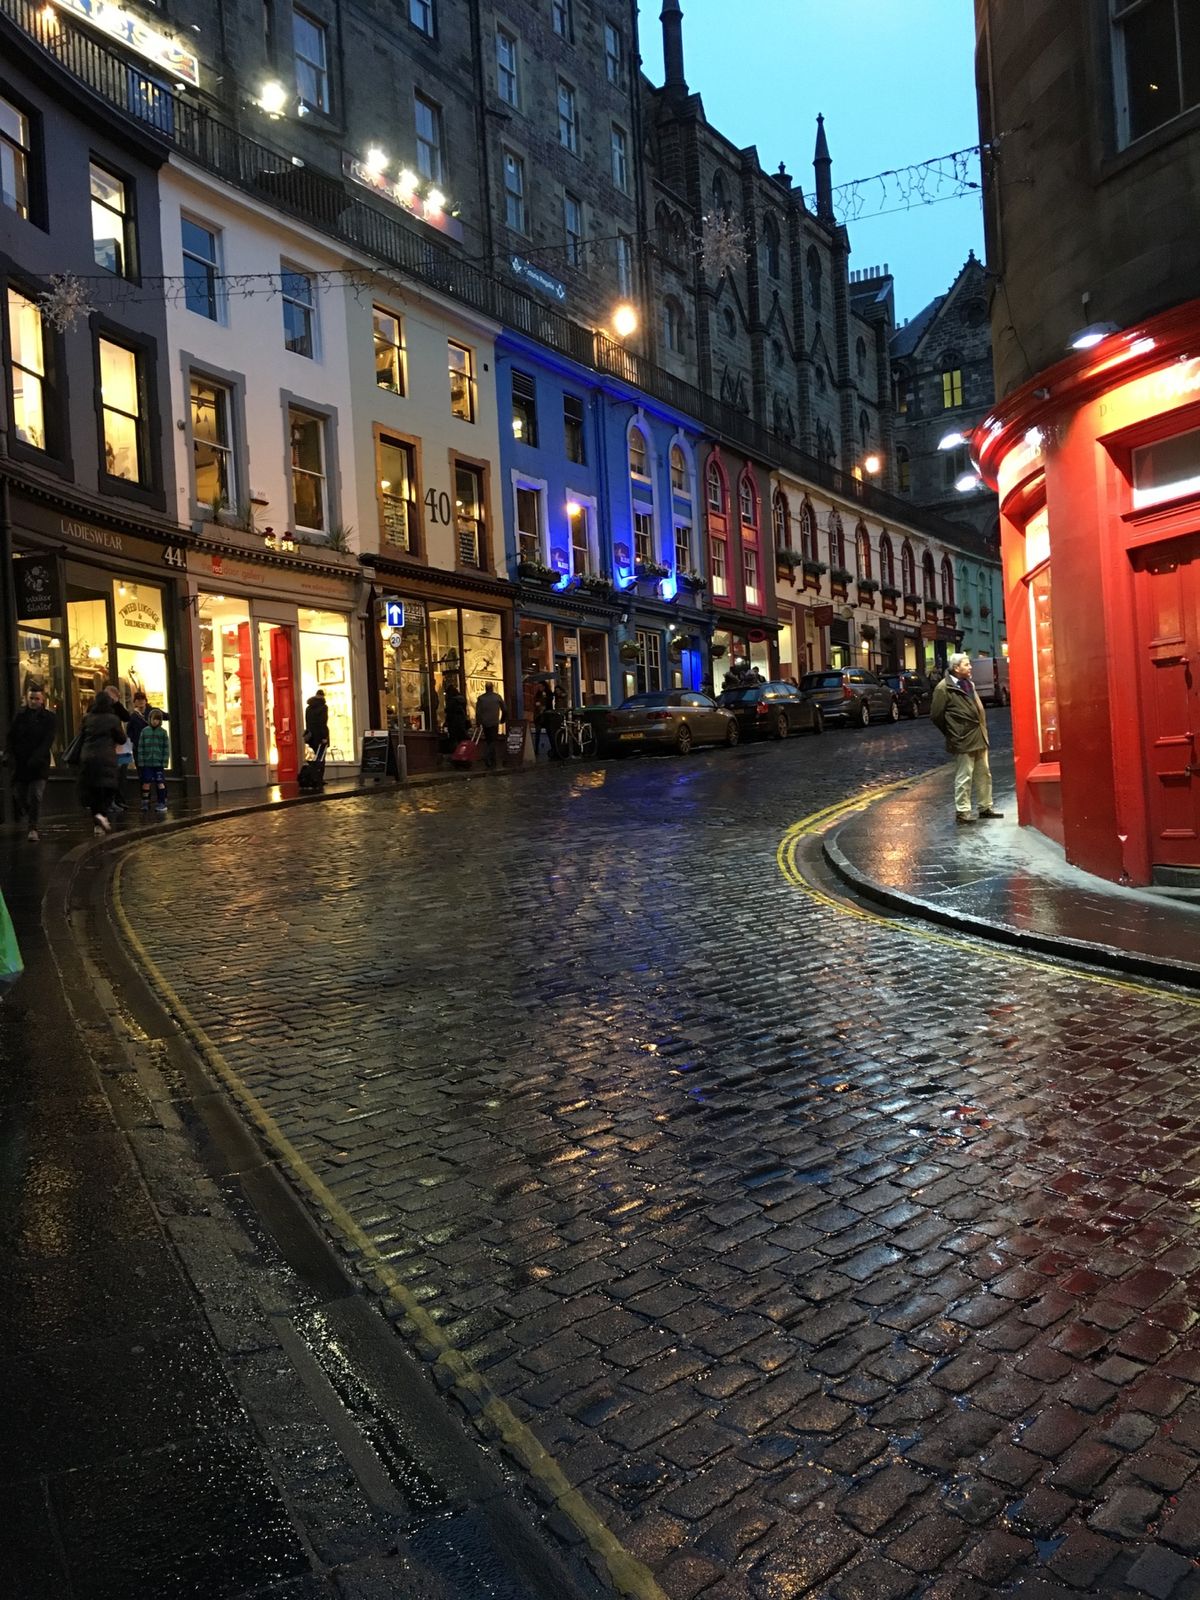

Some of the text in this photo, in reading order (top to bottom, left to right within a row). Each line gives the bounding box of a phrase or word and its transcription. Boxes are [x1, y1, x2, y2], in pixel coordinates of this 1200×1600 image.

[424, 487, 451, 527] 40
[60, 519, 123, 551] LADIESWEAR
[118, 602, 161, 625] TWEED LUGGAGE
[391, 636, 401, 645] 20
[469, 679, 499, 693] MUSM
